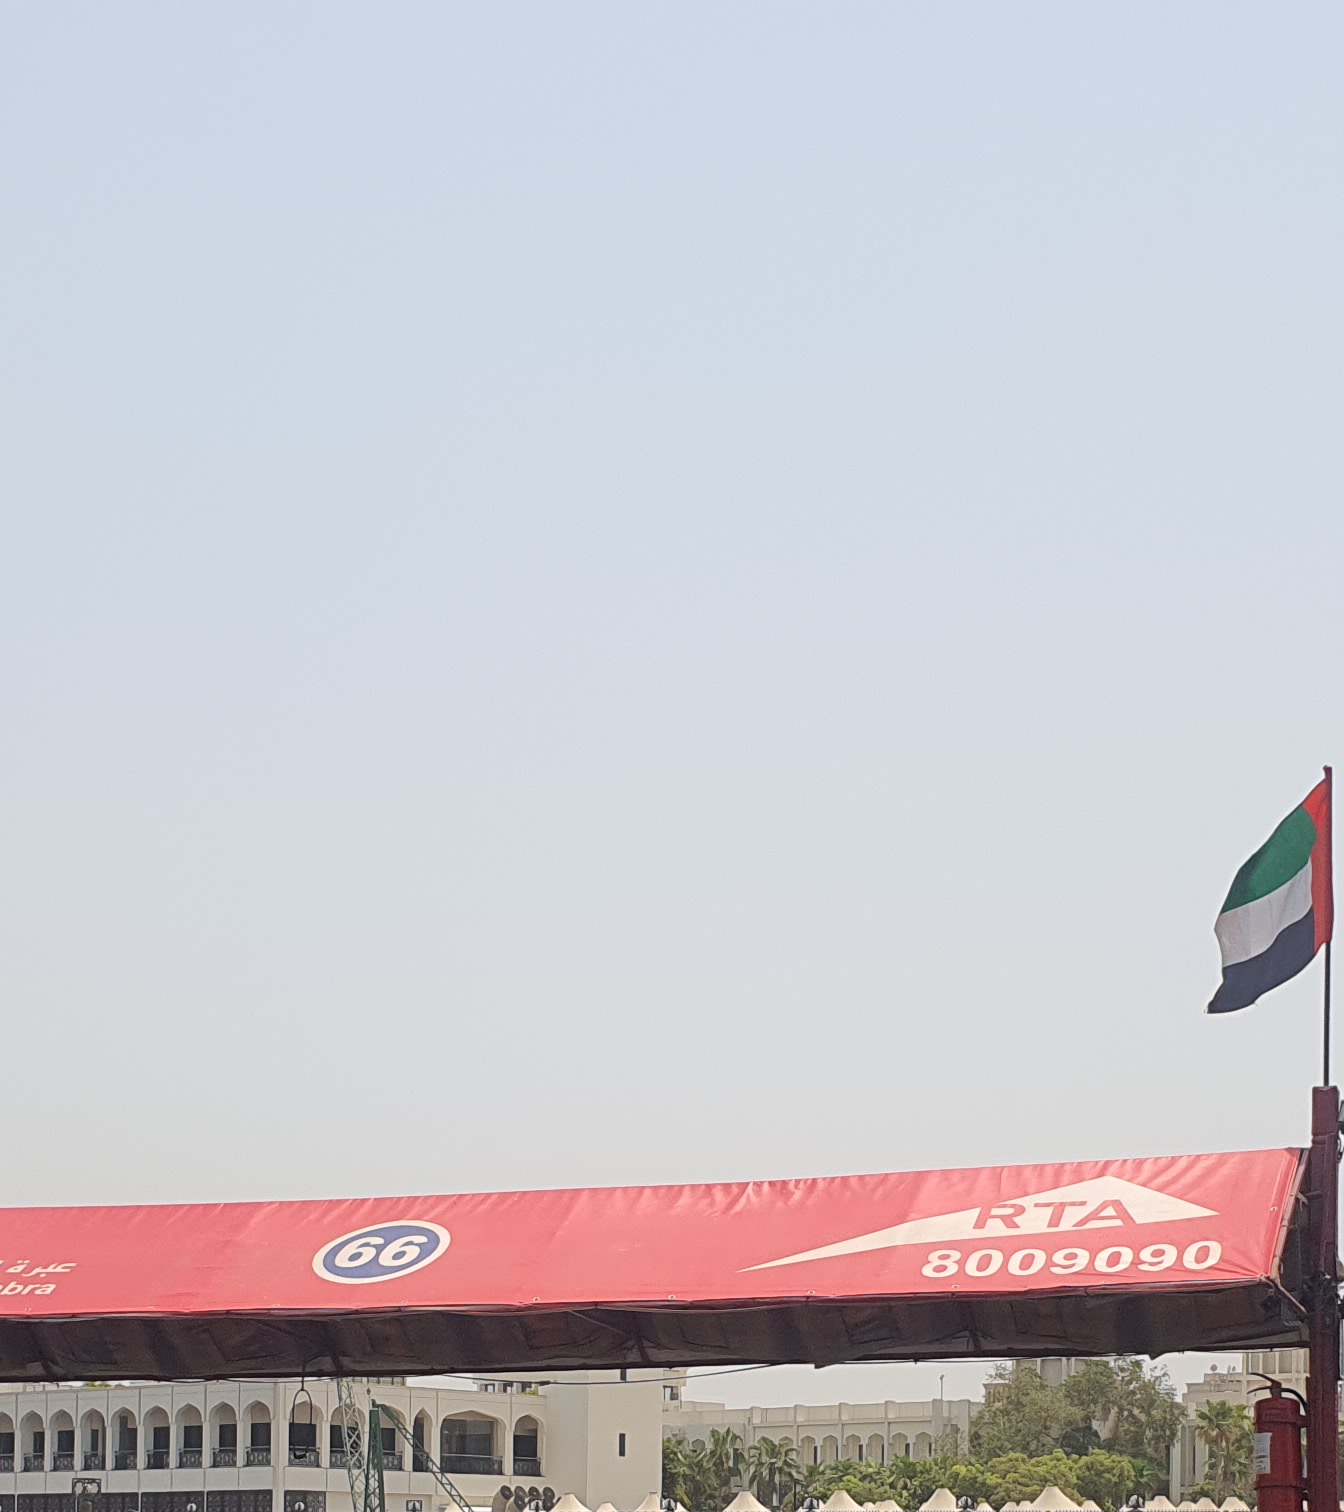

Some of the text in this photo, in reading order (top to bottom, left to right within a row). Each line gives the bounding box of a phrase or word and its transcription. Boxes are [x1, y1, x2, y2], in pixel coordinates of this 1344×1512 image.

[972, 1199, 1137, 1230] RTA
[334, 1235, 429, 1268] 66
[921, 1240, 1222, 1278] 8009090
[6, 1259, 77, 1277] عبرة
